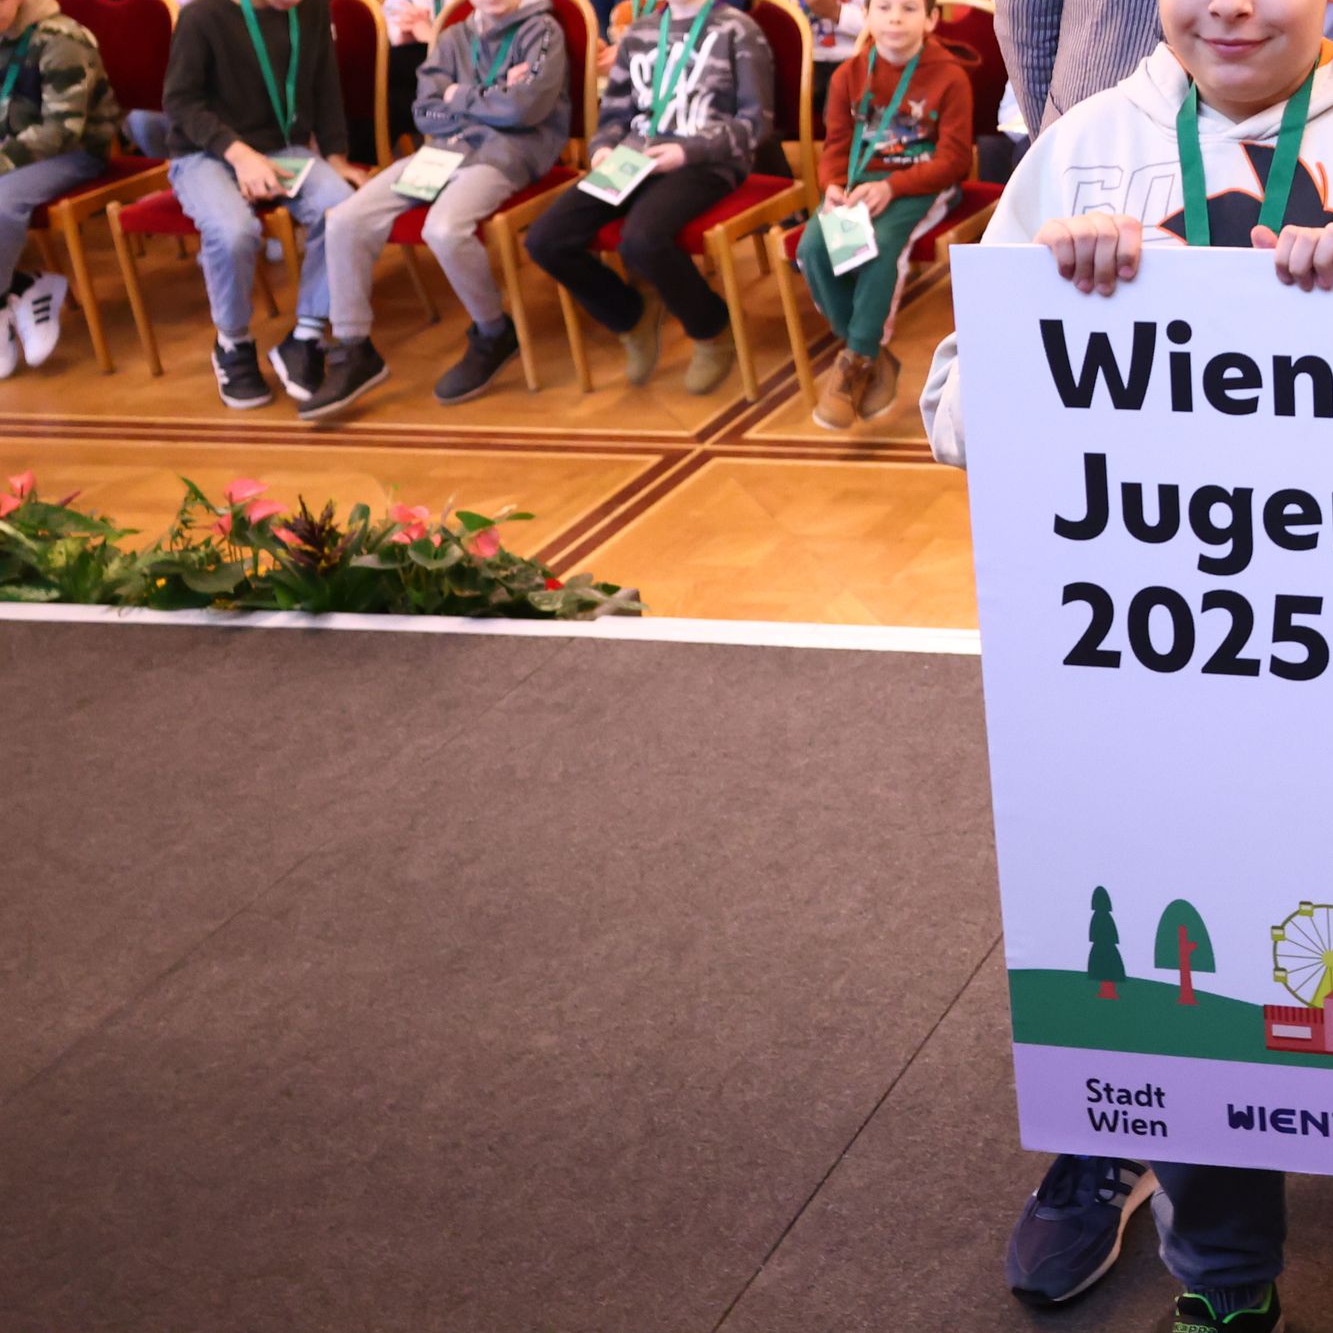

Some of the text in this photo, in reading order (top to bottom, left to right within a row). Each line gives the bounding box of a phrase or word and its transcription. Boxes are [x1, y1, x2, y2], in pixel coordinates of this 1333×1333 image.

[1061, 581, 1330, 682] 2025
[1085, 1077, 1166, 1109] Stadt
[1086, 1107, 1168, 1138] Wien
